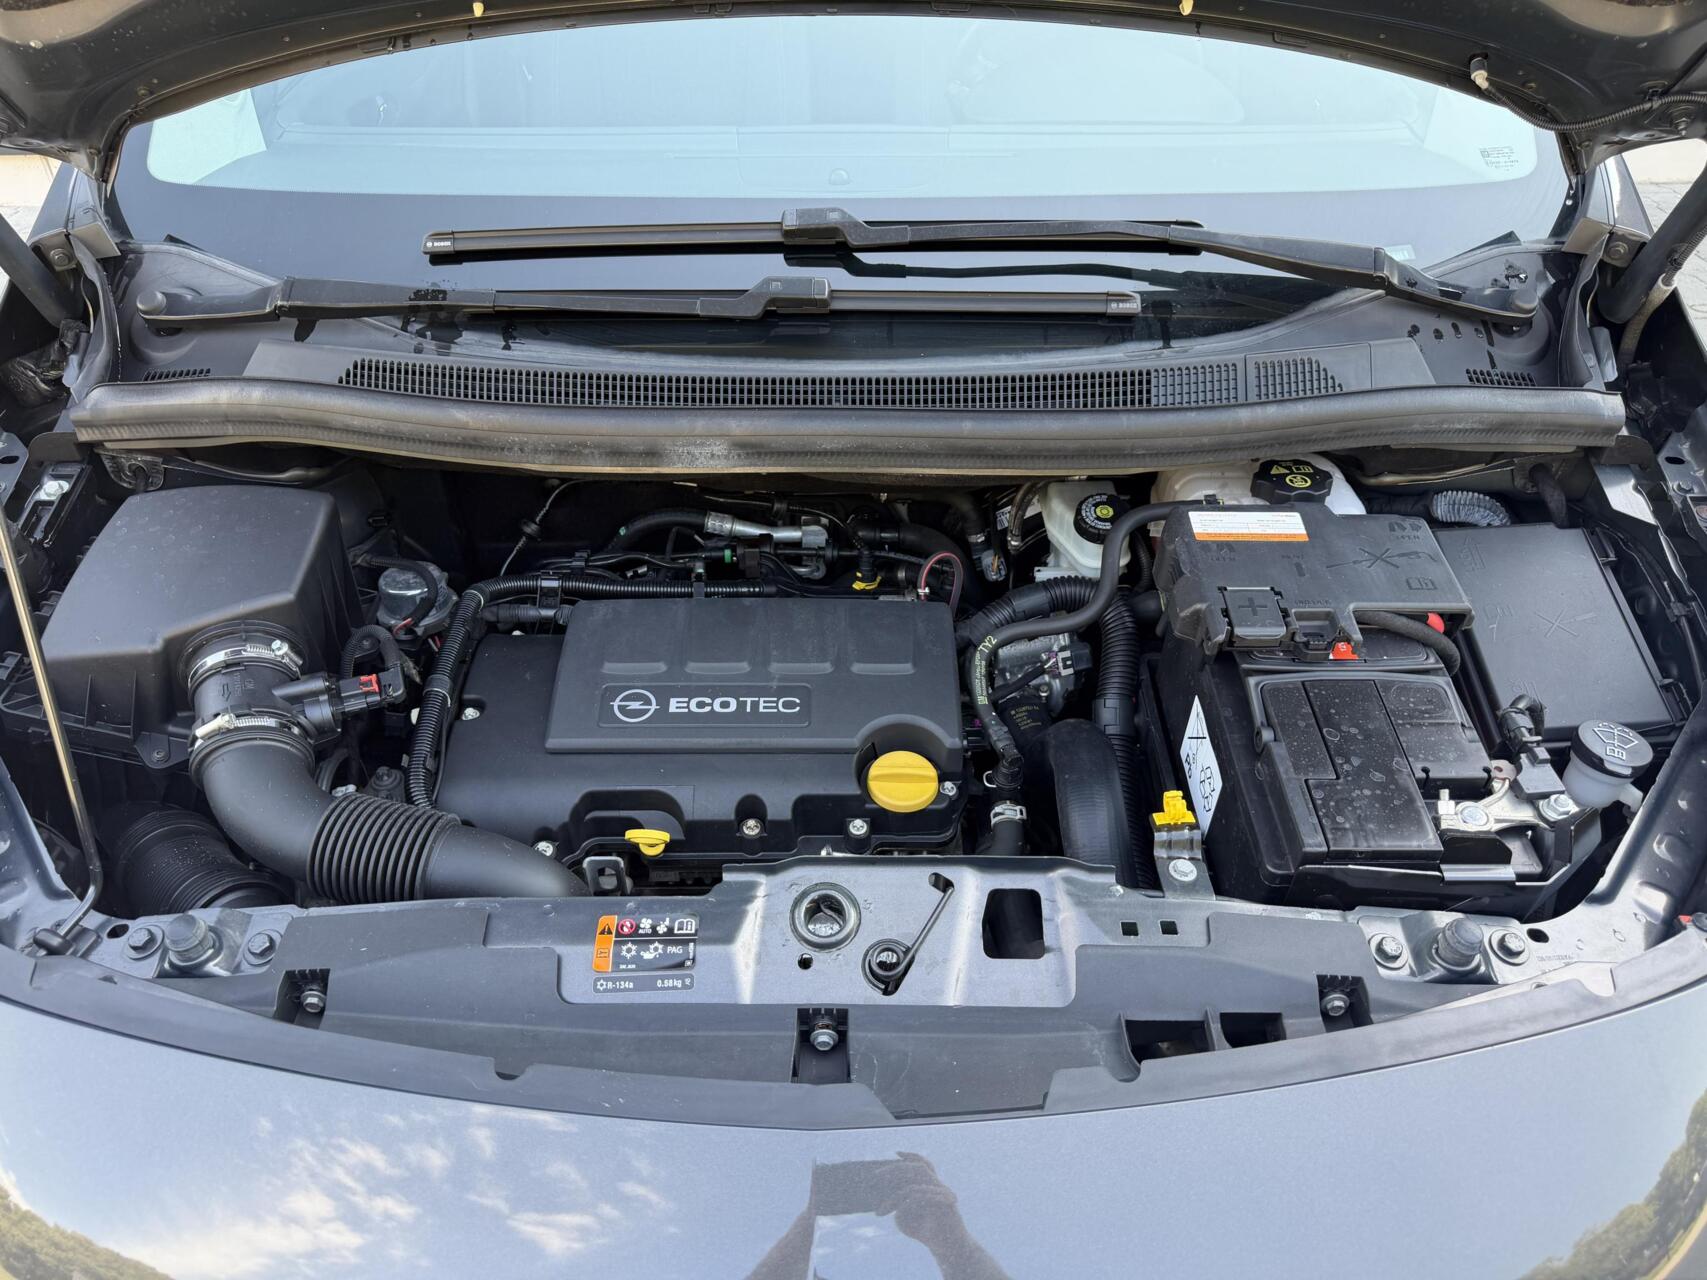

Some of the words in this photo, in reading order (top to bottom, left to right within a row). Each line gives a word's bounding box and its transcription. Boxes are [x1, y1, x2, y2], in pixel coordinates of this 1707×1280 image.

[977, 635, 998, 653] TY2
[668, 697, 801, 713] ECOTEC
[667, 946, 683, 954] PAG
[607, 981, 634, 989] R-134a
